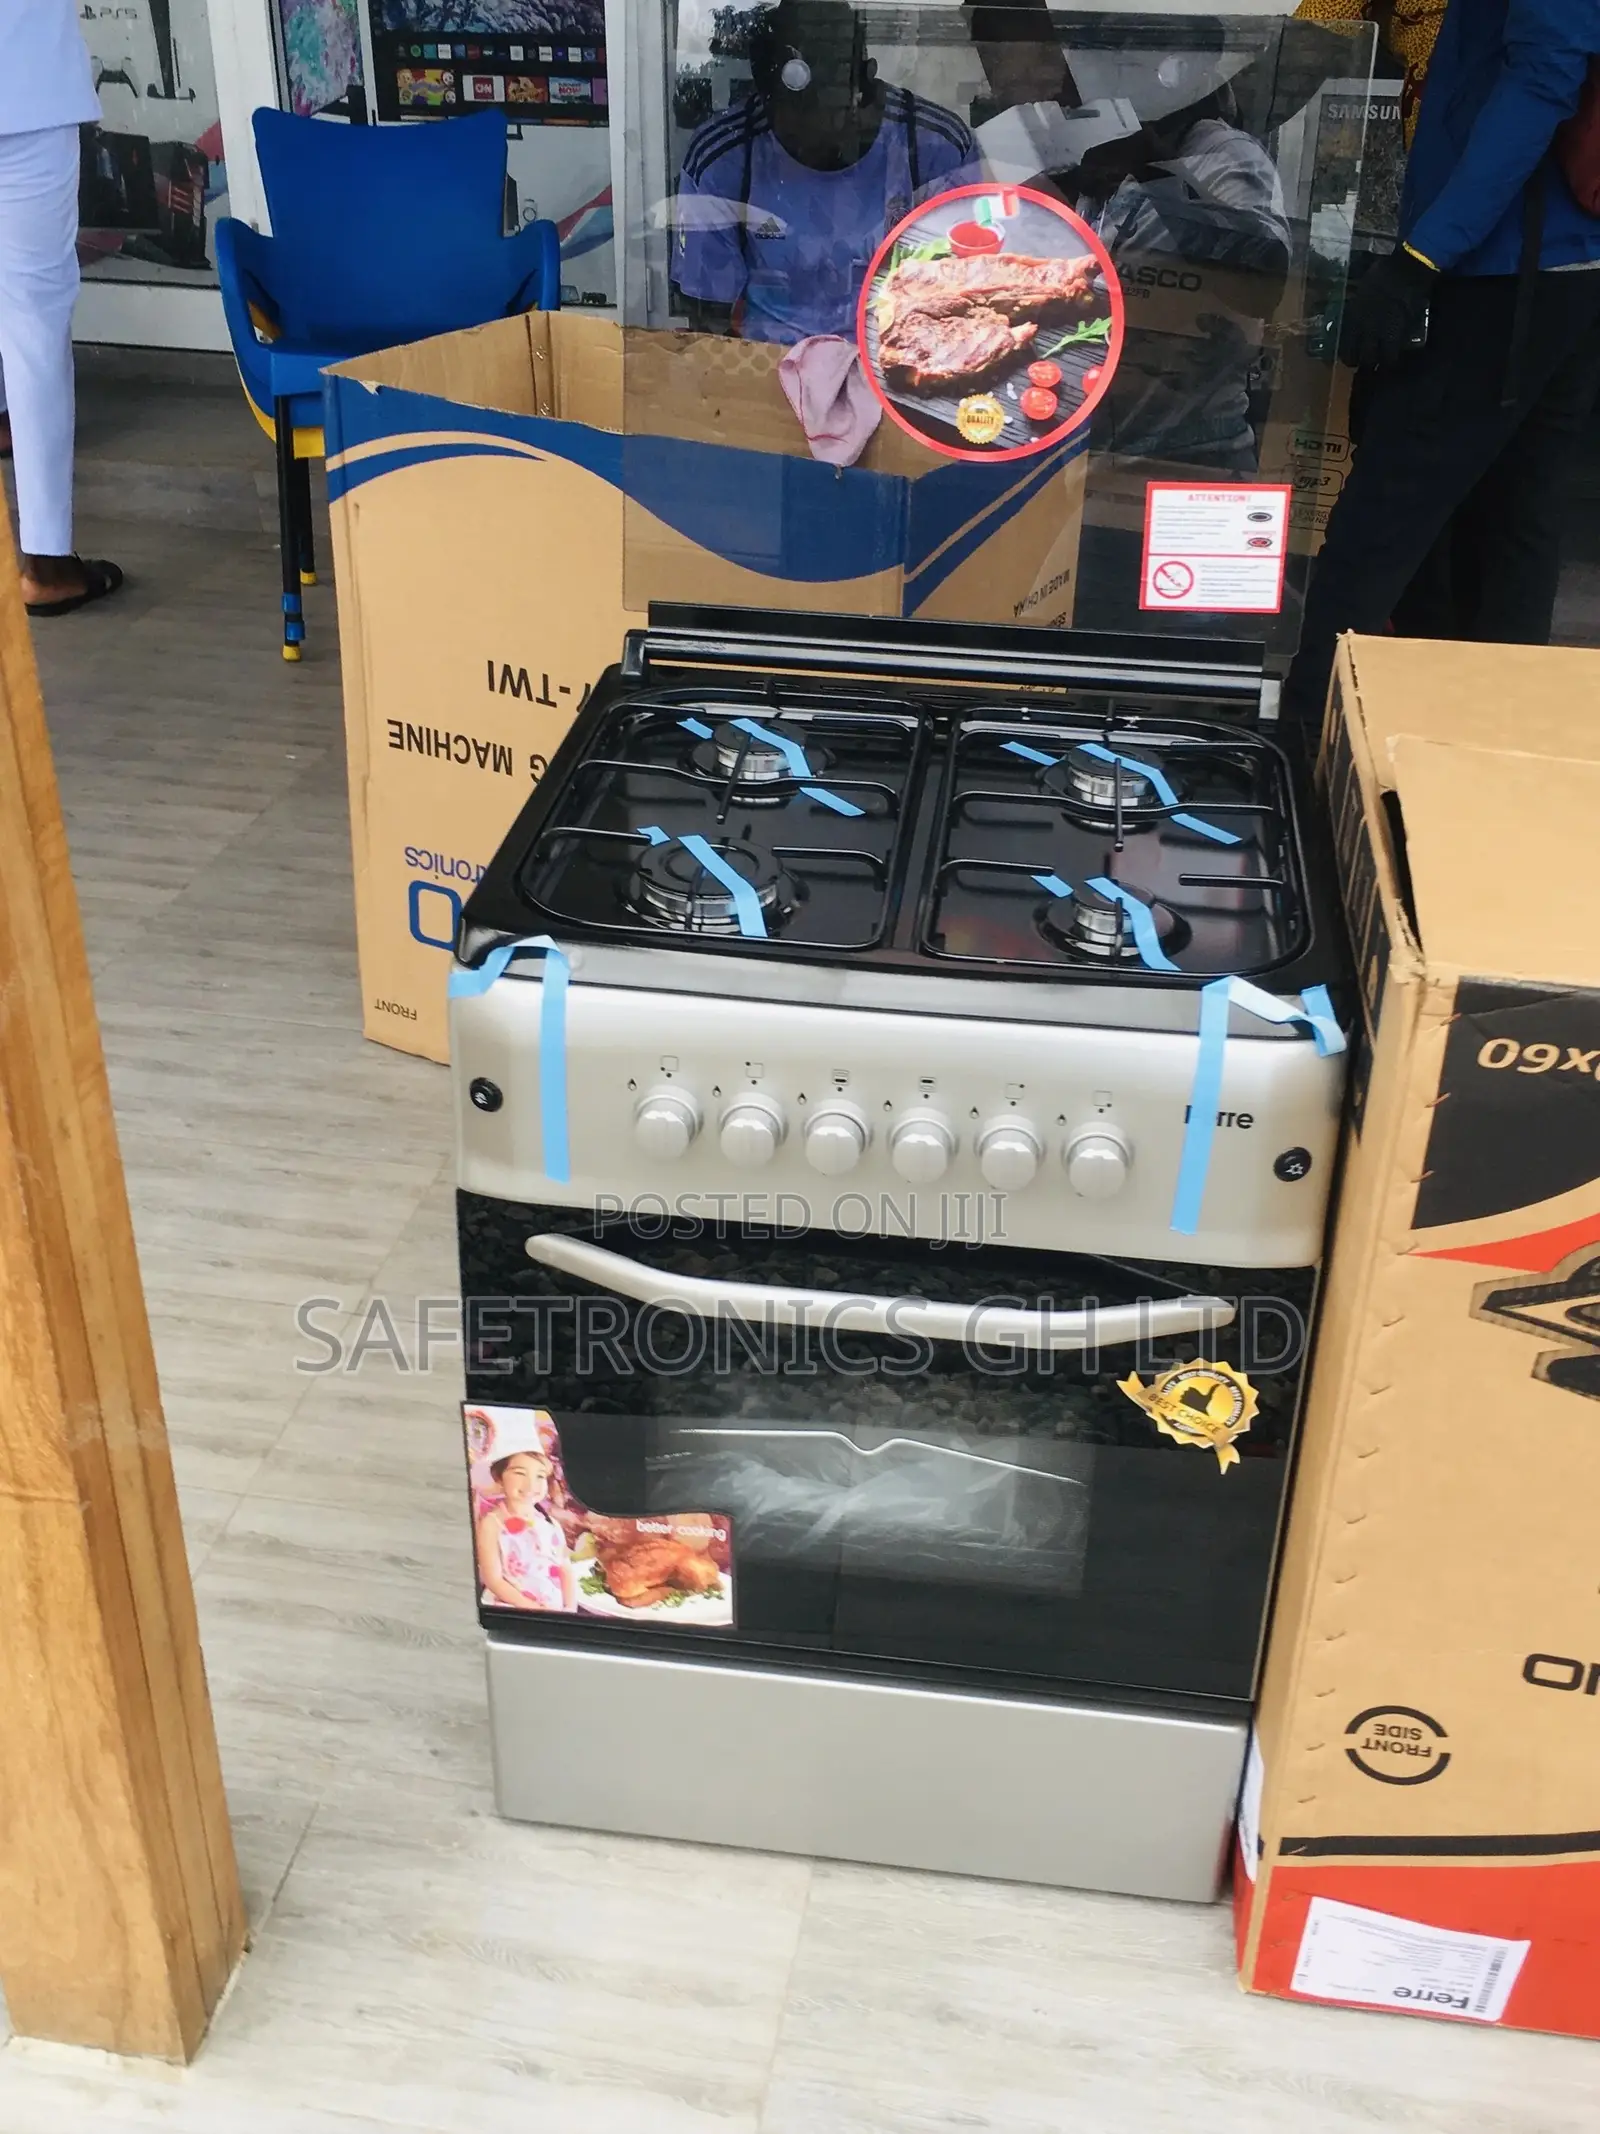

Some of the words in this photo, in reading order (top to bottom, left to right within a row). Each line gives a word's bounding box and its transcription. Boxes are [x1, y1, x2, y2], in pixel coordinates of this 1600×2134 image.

[475, 83, 493, 94] CNN
[1328, 103, 1400, 120] SAMSUN
[1118, 263, 1202, 291] ASCO
[966, 415, 994, 425] QUALITY
[387, 719, 513, 776] MACHINE
[404, 846, 488, 884] ronics
[374, 998, 417, 1021] FRONT
[1477, 1038, 1600, 1081] x60
[1183, 1104, 1254, 1129] rre
[1148, 1393, 1177, 1412] BEST
[1178, 1409, 1222, 1435] CHOICE
[636, 1518, 673, 1534] better
[676, 1525, 727, 1541] cooking
[1373, 1723, 1423, 1741] SIDE
[1360, 1737, 1433, 1758] FRONT
[1392, 1985, 1470, 2010] Ferre
